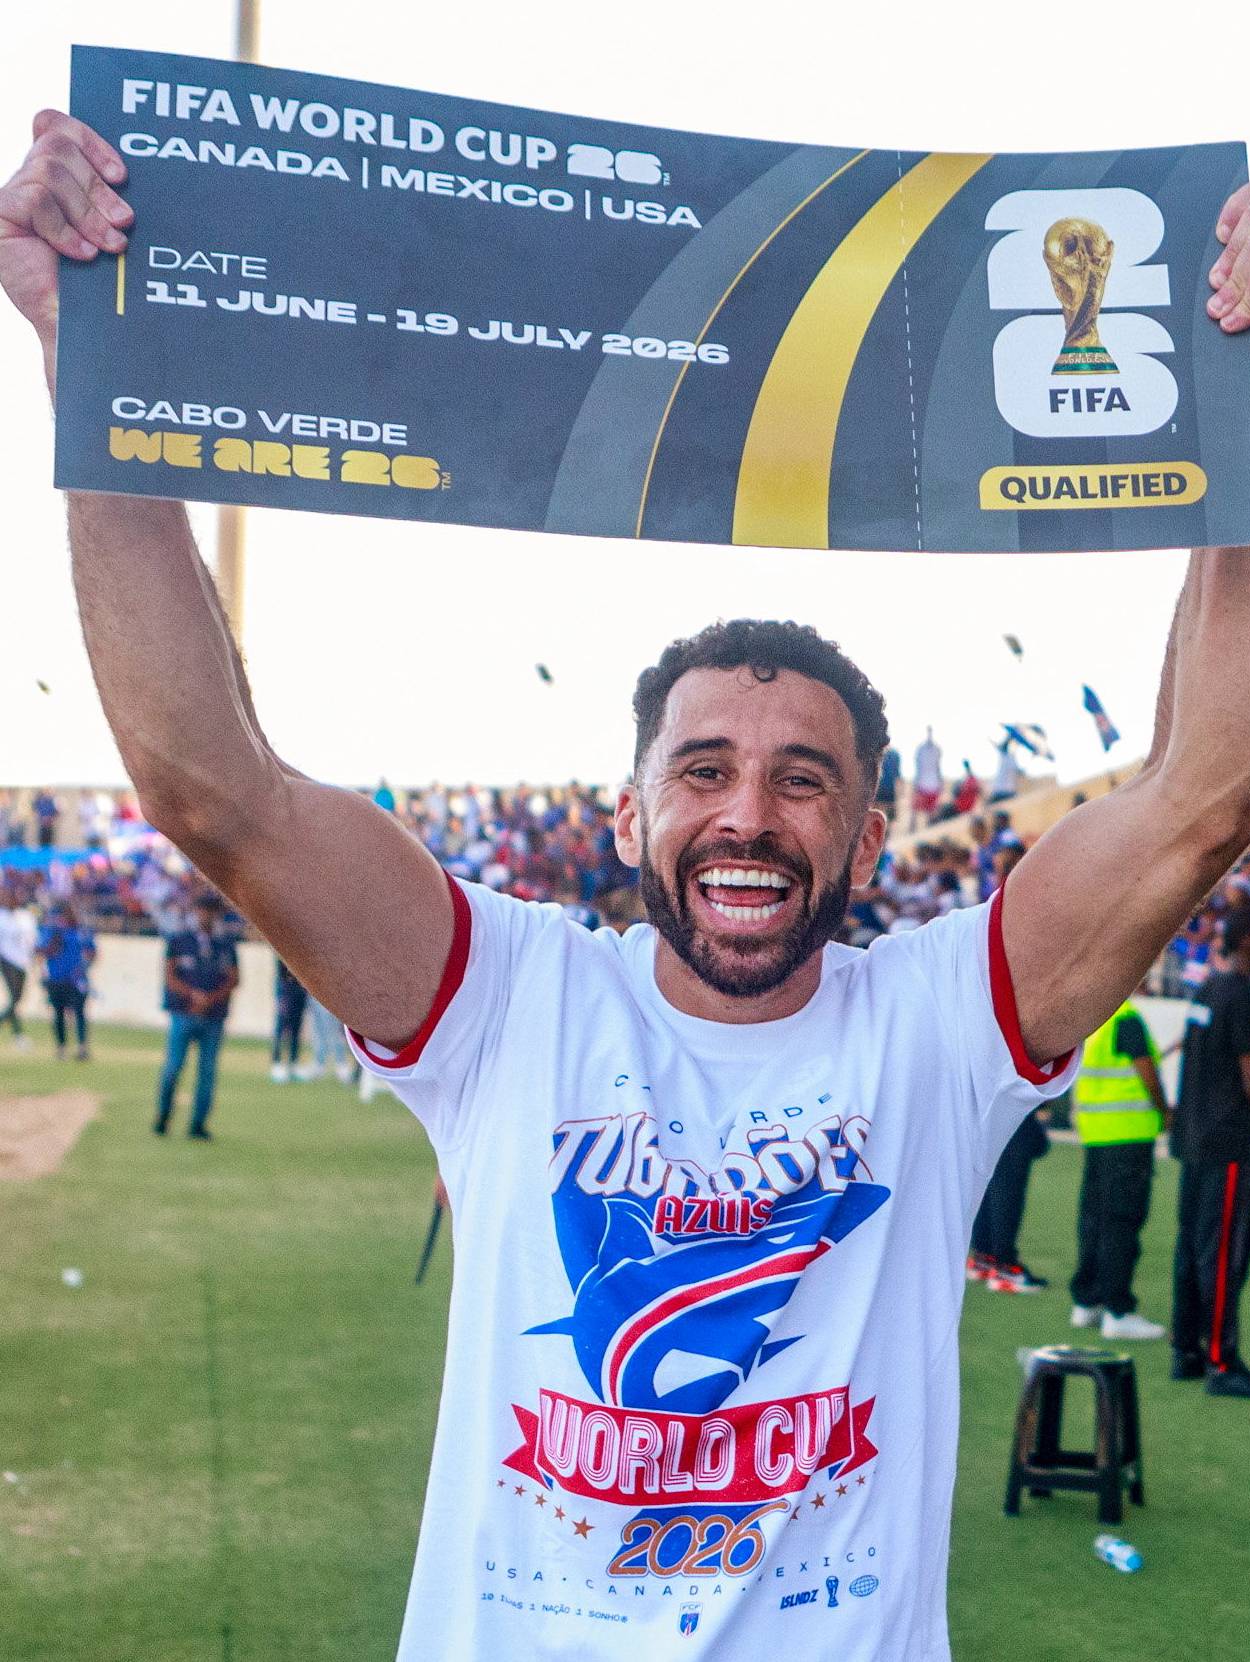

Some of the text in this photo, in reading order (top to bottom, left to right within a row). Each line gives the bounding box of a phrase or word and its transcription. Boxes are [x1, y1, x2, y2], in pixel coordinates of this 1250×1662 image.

[122, 79, 662, 186] FIFA WORLD CUP 26
[119, 133, 702, 228] CANADA MEXICO USA
[149, 246, 268, 280] DATE
[146, 280, 208, 308] 11
[215, 290, 357, 325] JUNE
[396, 308, 460, 336] 19
[467, 320, 592, 351] JULY
[601, 334, 731, 365] 2026
[111, 396, 409, 447] CABO VERDE
[1048, 387, 1131, 413] FIFA
[109, 427, 202, 469] WE
[341, 450, 440, 490] 26
[1000, 472, 1187, 503] QUALIFIED
[653, 1194, 775, 1238] AZUIS
[541, 1393, 736, 1495] WORLD
[607, 1498, 791, 1579] 2026
[486, 1546, 876, 1597] USA CANADA EXICO
